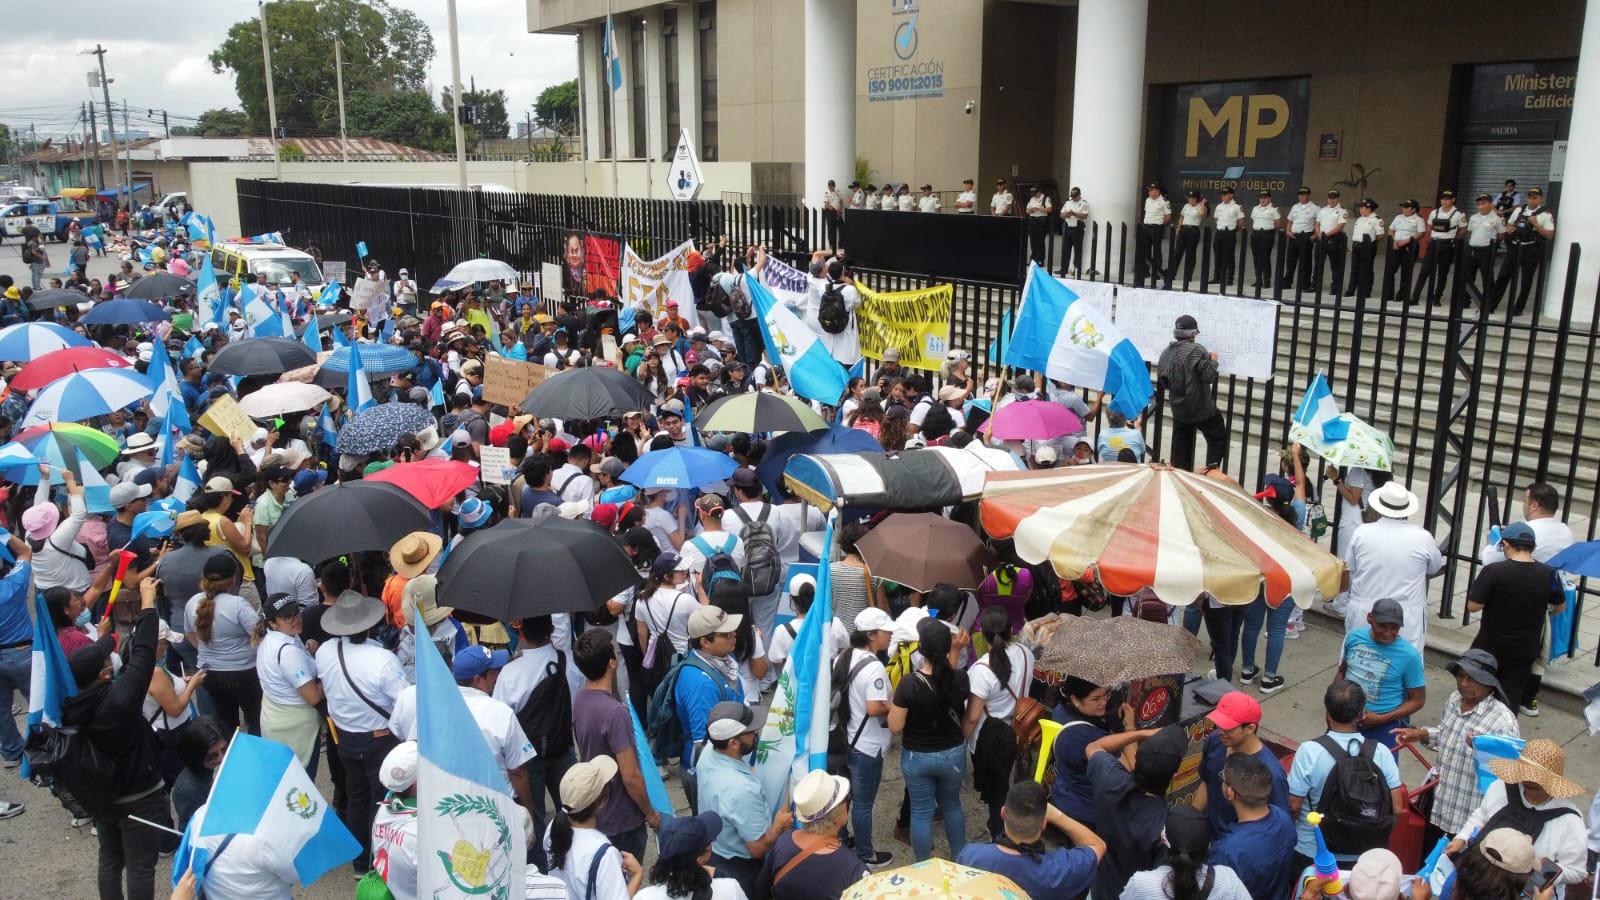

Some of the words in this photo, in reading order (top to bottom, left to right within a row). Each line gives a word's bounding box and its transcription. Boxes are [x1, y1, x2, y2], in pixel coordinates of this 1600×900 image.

[867, 59, 944, 80] CERTIFICACIÓN
[868, 80, 886, 94] ISO
[888, 75, 943, 92] 9001:2015
[1185, 94, 1290, 158] MP
[1490, 127, 1518, 135] SALIDA
[1182, 179, 1238, 191] MINISTERIO
[1240, 177, 1286, 191] PÚBLICO
[893, 300, 918, 323] JUAN
[929, 290, 950, 323] DIOS
